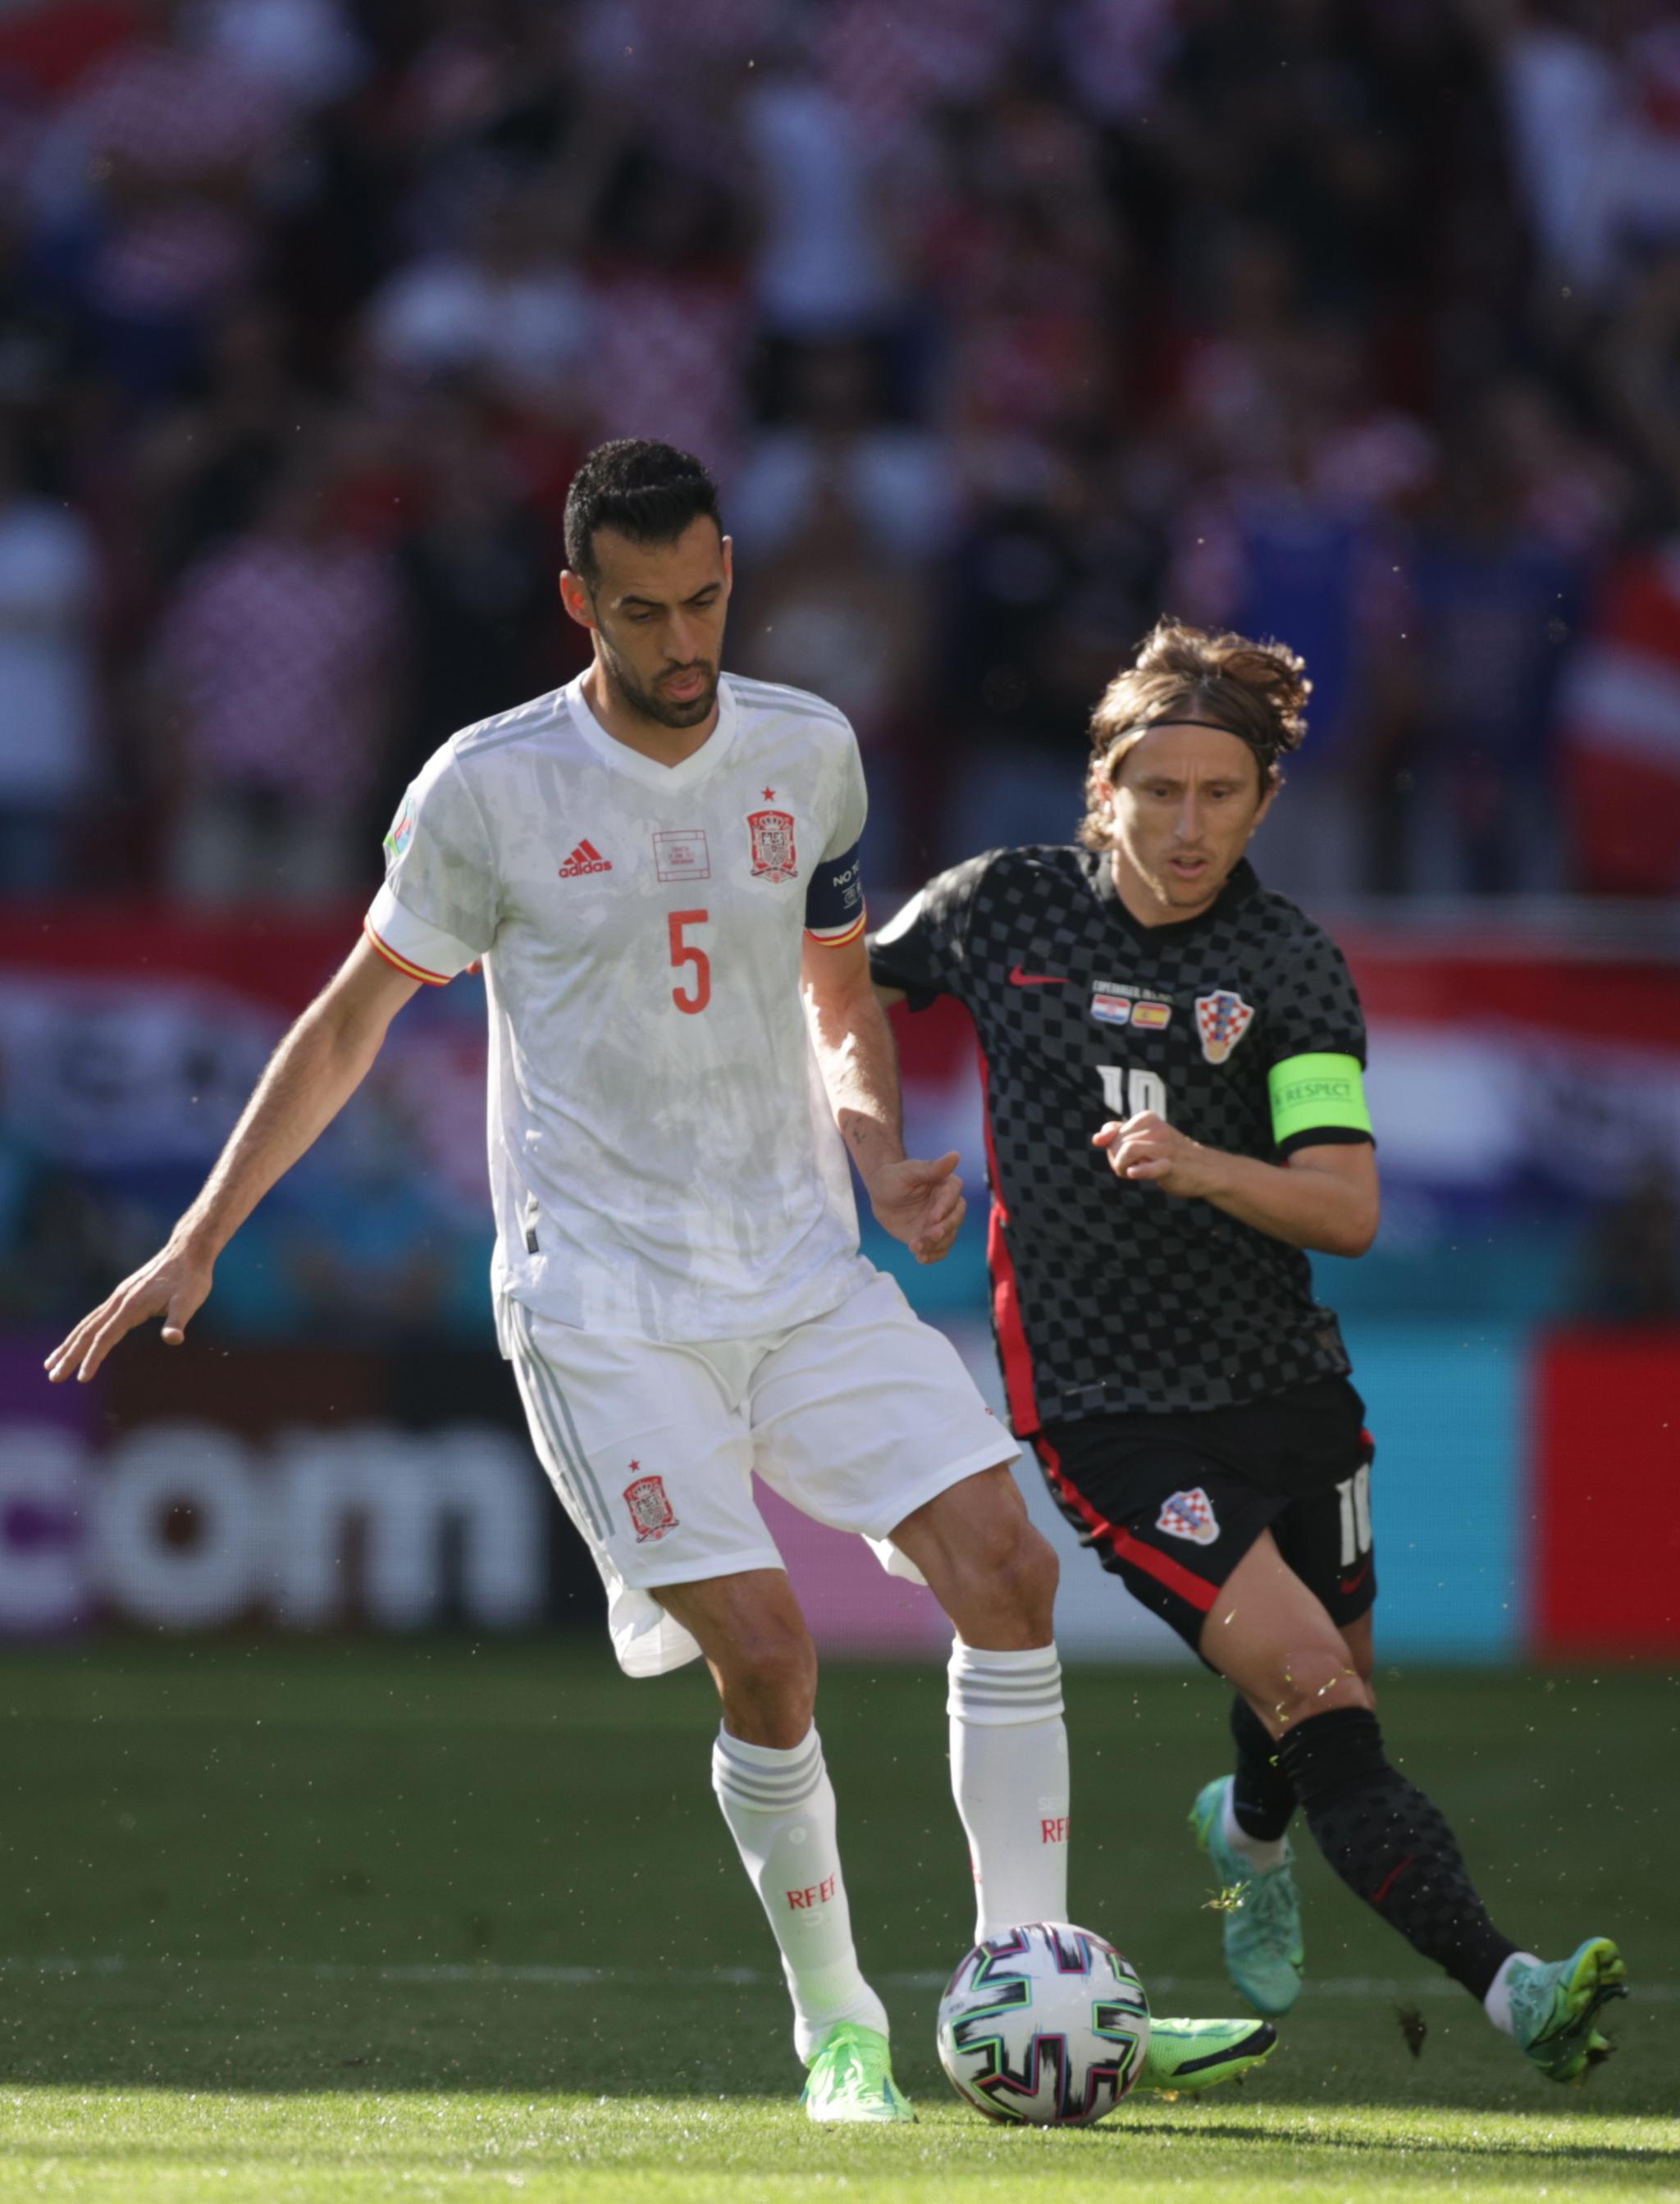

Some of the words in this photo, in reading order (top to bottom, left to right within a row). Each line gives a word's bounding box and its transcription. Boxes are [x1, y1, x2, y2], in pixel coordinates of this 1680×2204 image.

[559, 860, 613, 878] adidas
[833, 870, 851, 887] NO
[669, 909, 710, 1015] 5
[1096, 1065, 1166, 1122] 10
[1285, 1083, 1351, 1102] RESPECT
